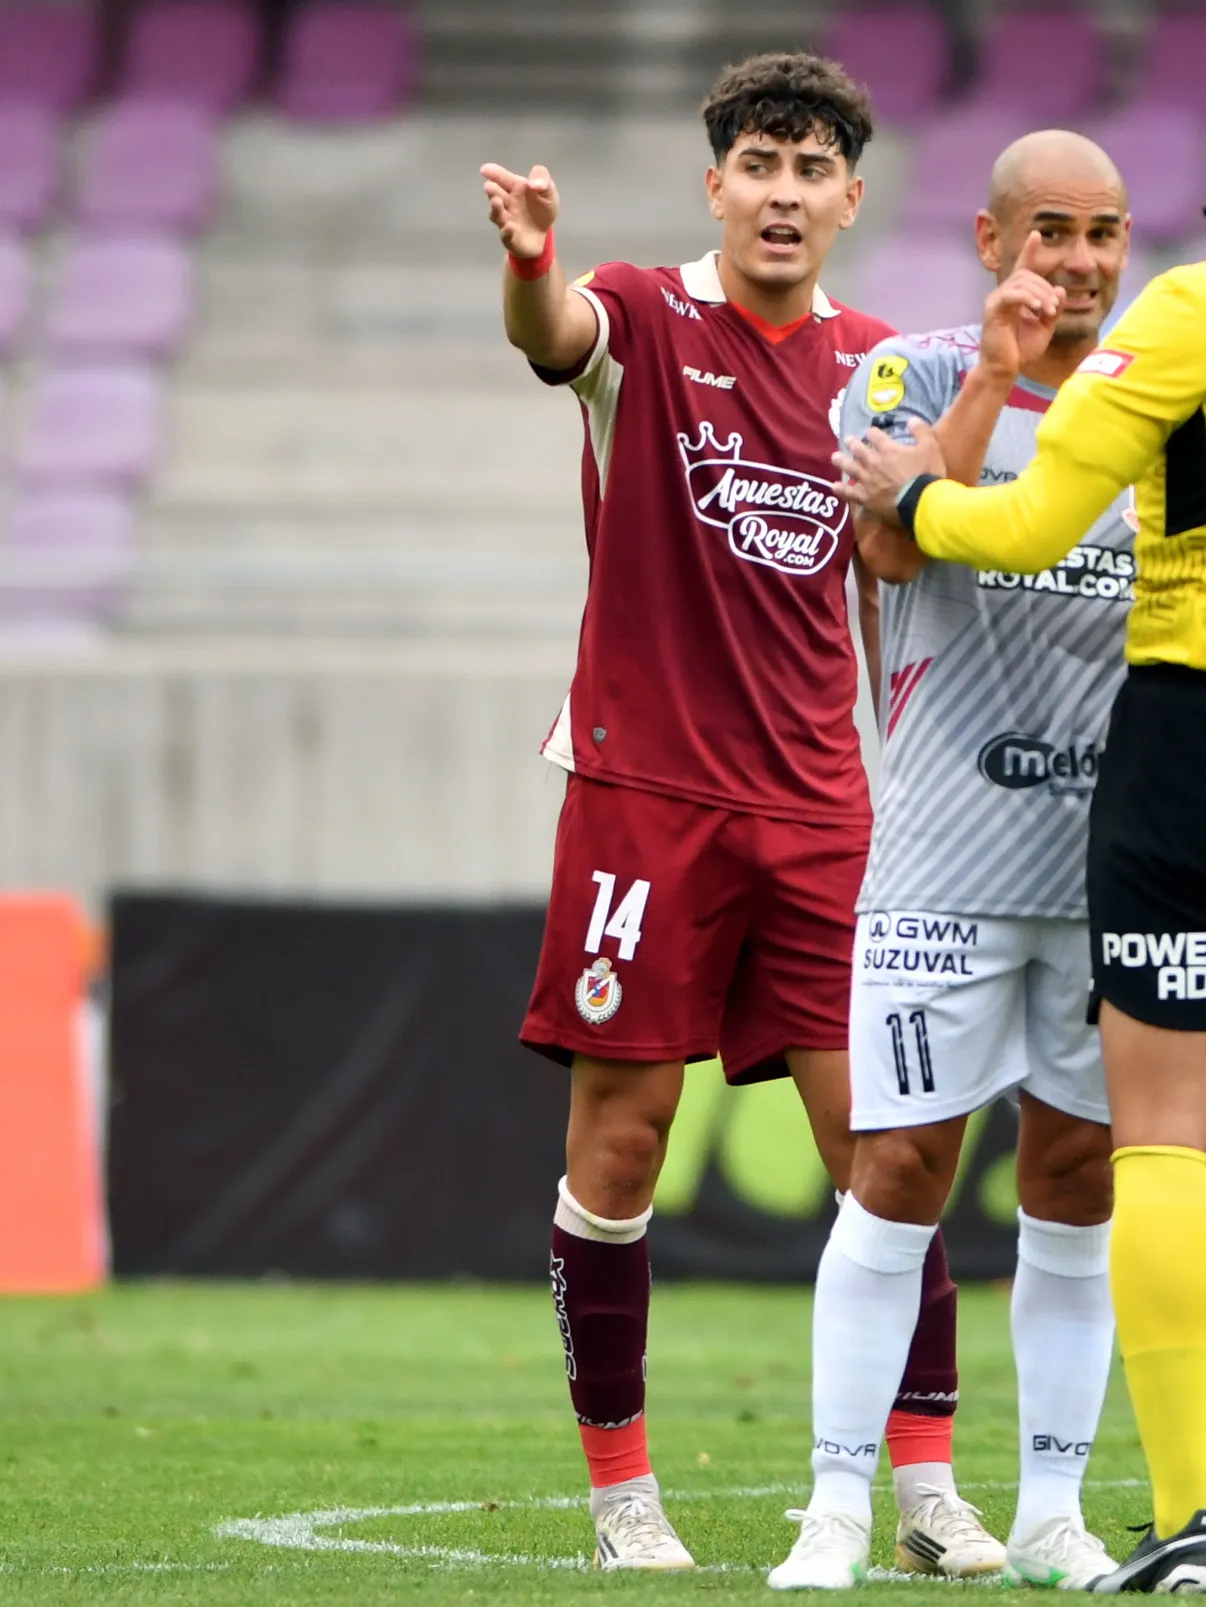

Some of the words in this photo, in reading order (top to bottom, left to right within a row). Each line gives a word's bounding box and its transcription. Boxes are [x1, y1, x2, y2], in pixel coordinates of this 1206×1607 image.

[682, 365, 737, 390] FIUME
[697, 467, 839, 518] Apuestas
[739, 516, 825, 560] Royal
[783, 554, 814, 567] .COM
[584, 869, 651, 961] 14
[896, 917, 978, 946] GWM
[863, 948, 973, 975] SUZUVAL
[886, 1010, 934, 1095] 11
